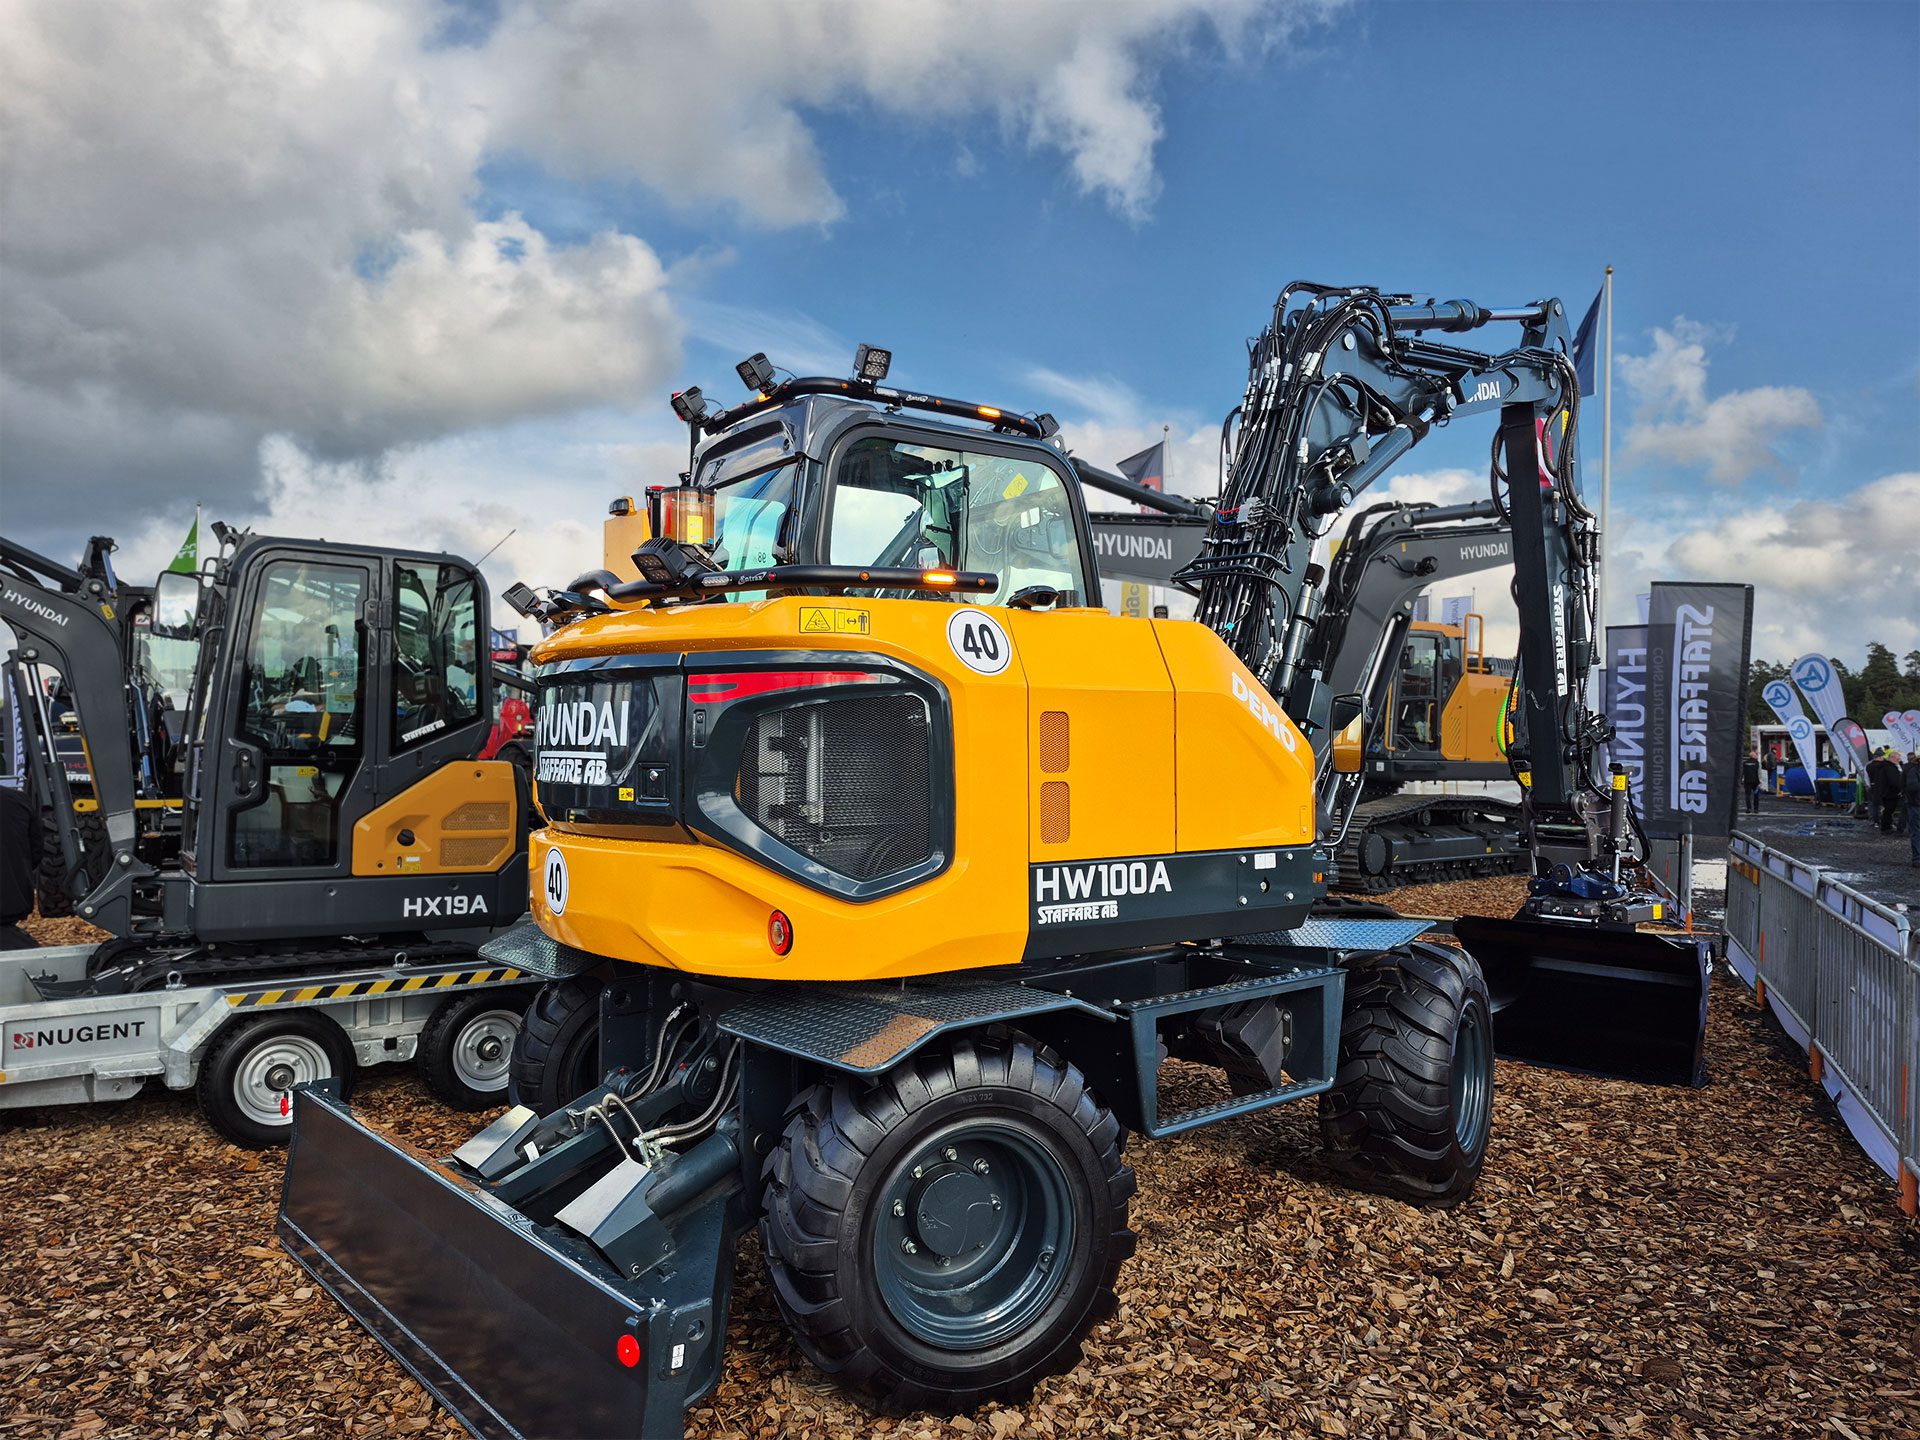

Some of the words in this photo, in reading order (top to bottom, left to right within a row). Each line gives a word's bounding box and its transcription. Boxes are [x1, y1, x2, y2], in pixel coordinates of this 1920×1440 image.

[1467, 380, 1500, 403] NDAI
[1092, 532, 1172, 560] HYUNDAI
[1460, 542, 1508, 560] HYUNDAI
[4, 589, 69, 627] HYUNDAI
[963, 623, 999, 661] 40
[1232, 671, 1296, 753] DEMO
[583, 759, 608, 785] AB
[548, 862, 562, 902] 40
[1036, 861, 1172, 902] HW100A
[403, 894, 488, 918] HX19A
[1038, 904, 1099, 925] STAFFARE
[1101, 904, 1119, 919] AB
[37, 1021, 146, 1047] NUGENT
